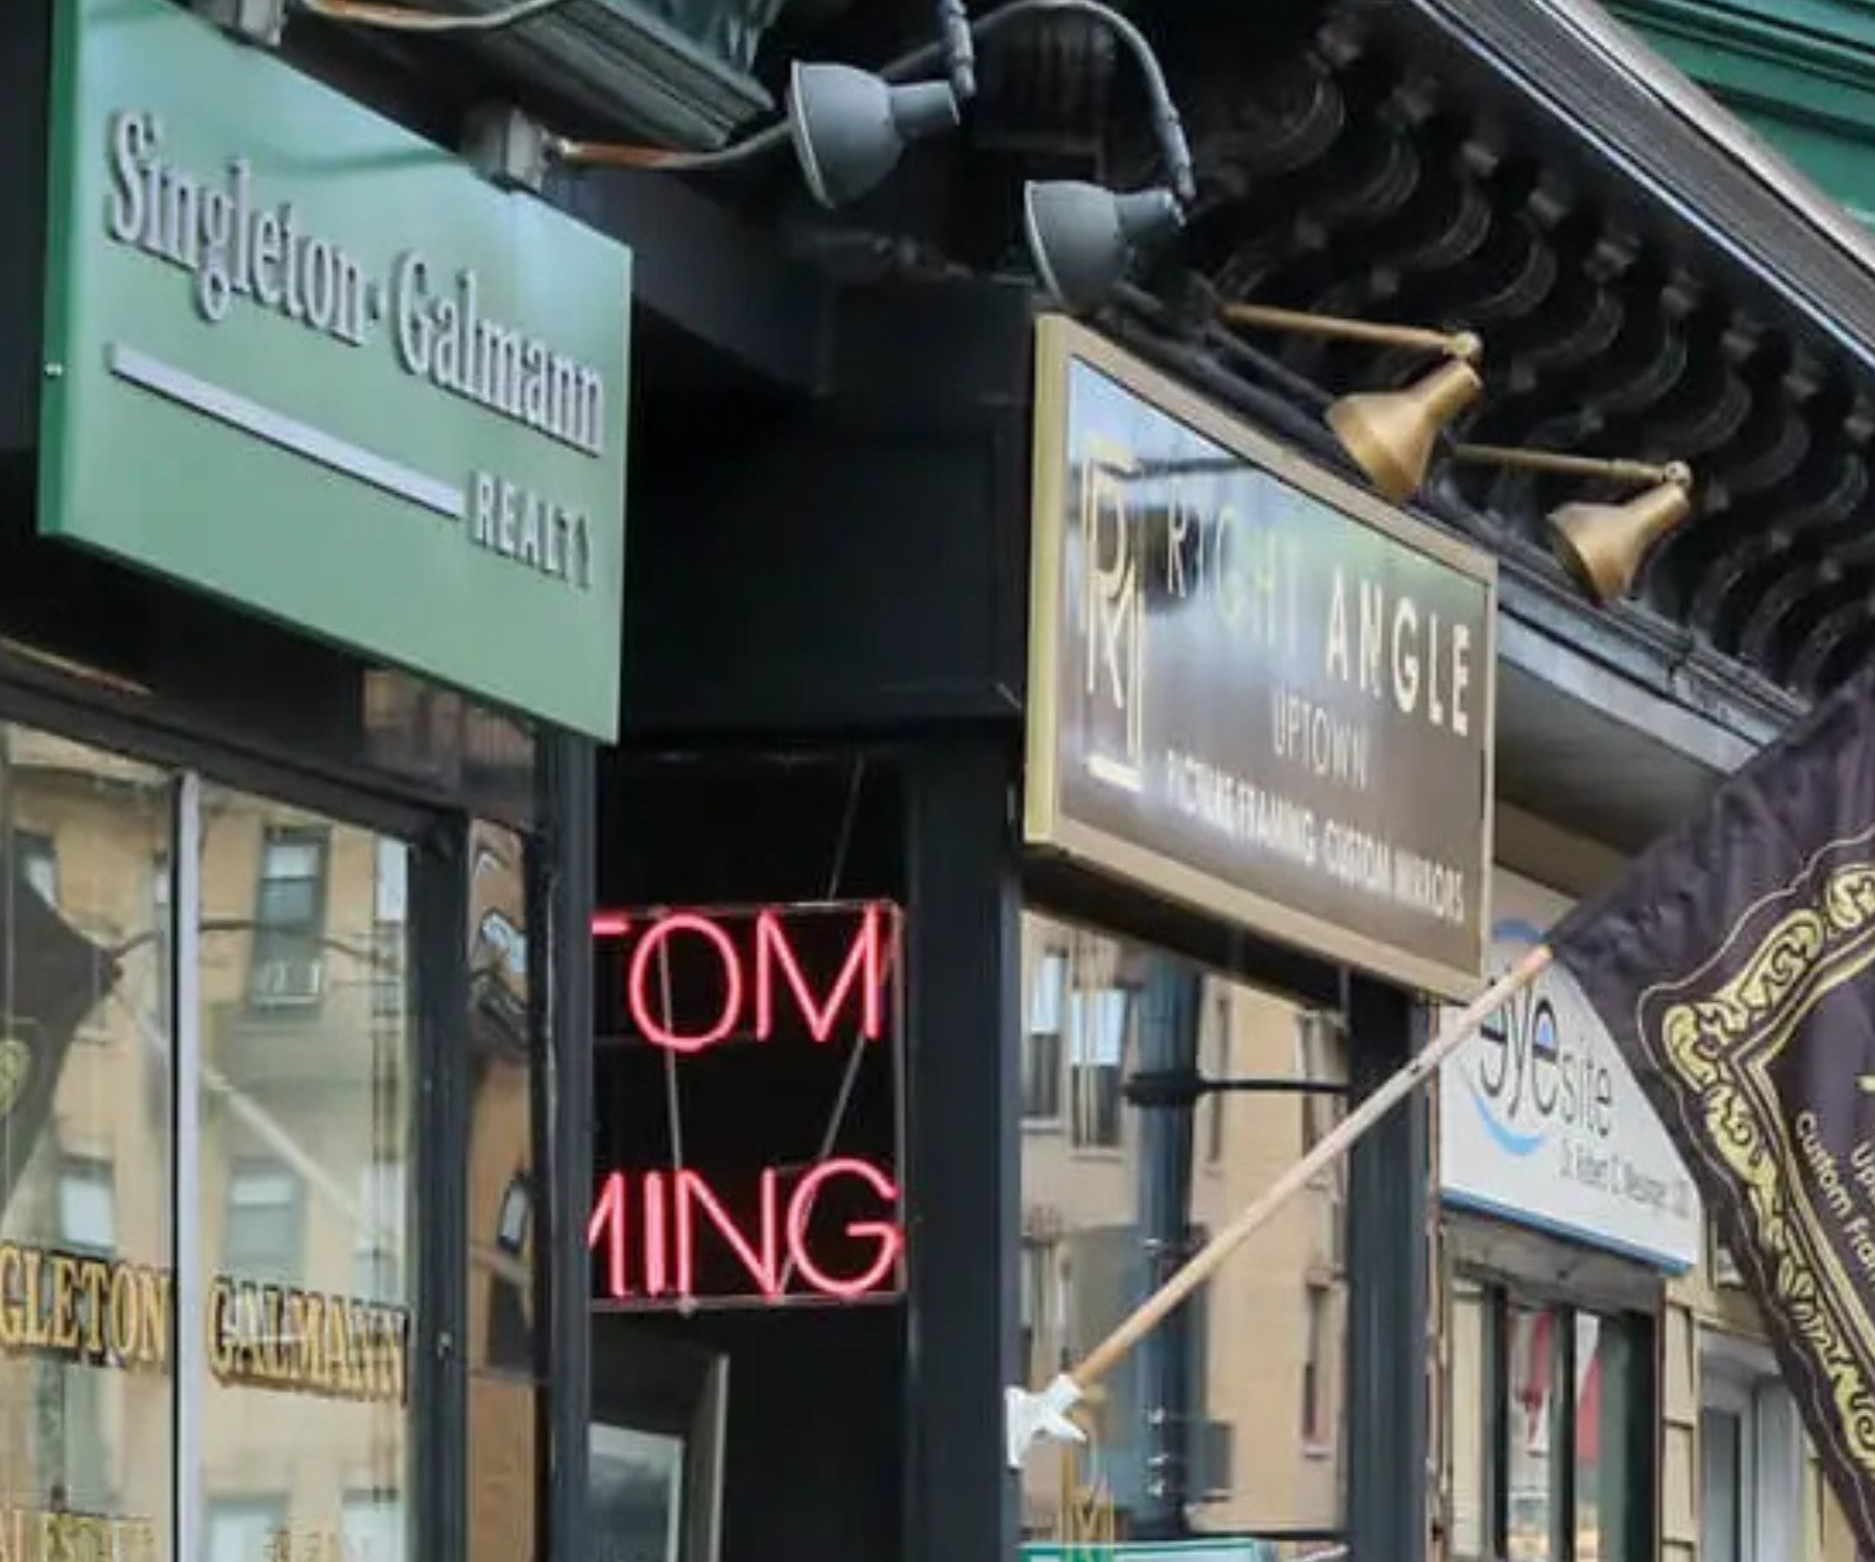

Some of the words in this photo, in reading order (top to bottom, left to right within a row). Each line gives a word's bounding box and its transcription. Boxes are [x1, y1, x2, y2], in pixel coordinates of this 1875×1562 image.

[108, 107, 367, 347] Singleton
[390, 249, 605, 459] Galmann
[474, 469, 592, 587] REALTY
[1325, 563, 1471, 737] ANGLE
[1272, 685, 1368, 790] UPTOWN
[1795, 1109, 1854, 1219] Custom
[207, 1269, 412, 1405] GALMANN
